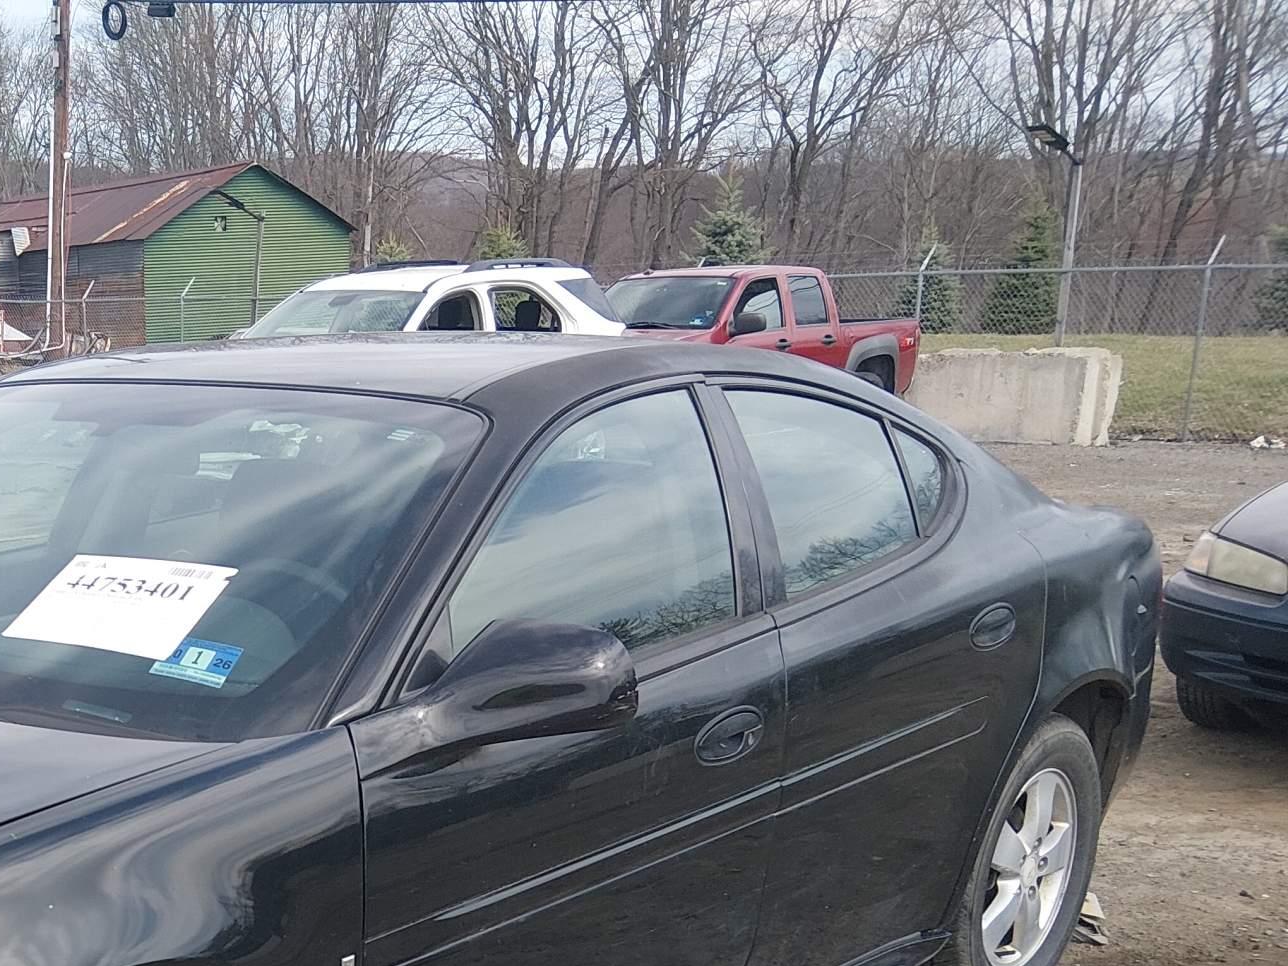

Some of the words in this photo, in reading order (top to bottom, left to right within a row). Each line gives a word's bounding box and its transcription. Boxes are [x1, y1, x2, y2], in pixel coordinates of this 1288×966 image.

[67, 574, 194, 600] 44753401
[191, 650, 204, 665] 1
[213, 658, 233, 670] 26
